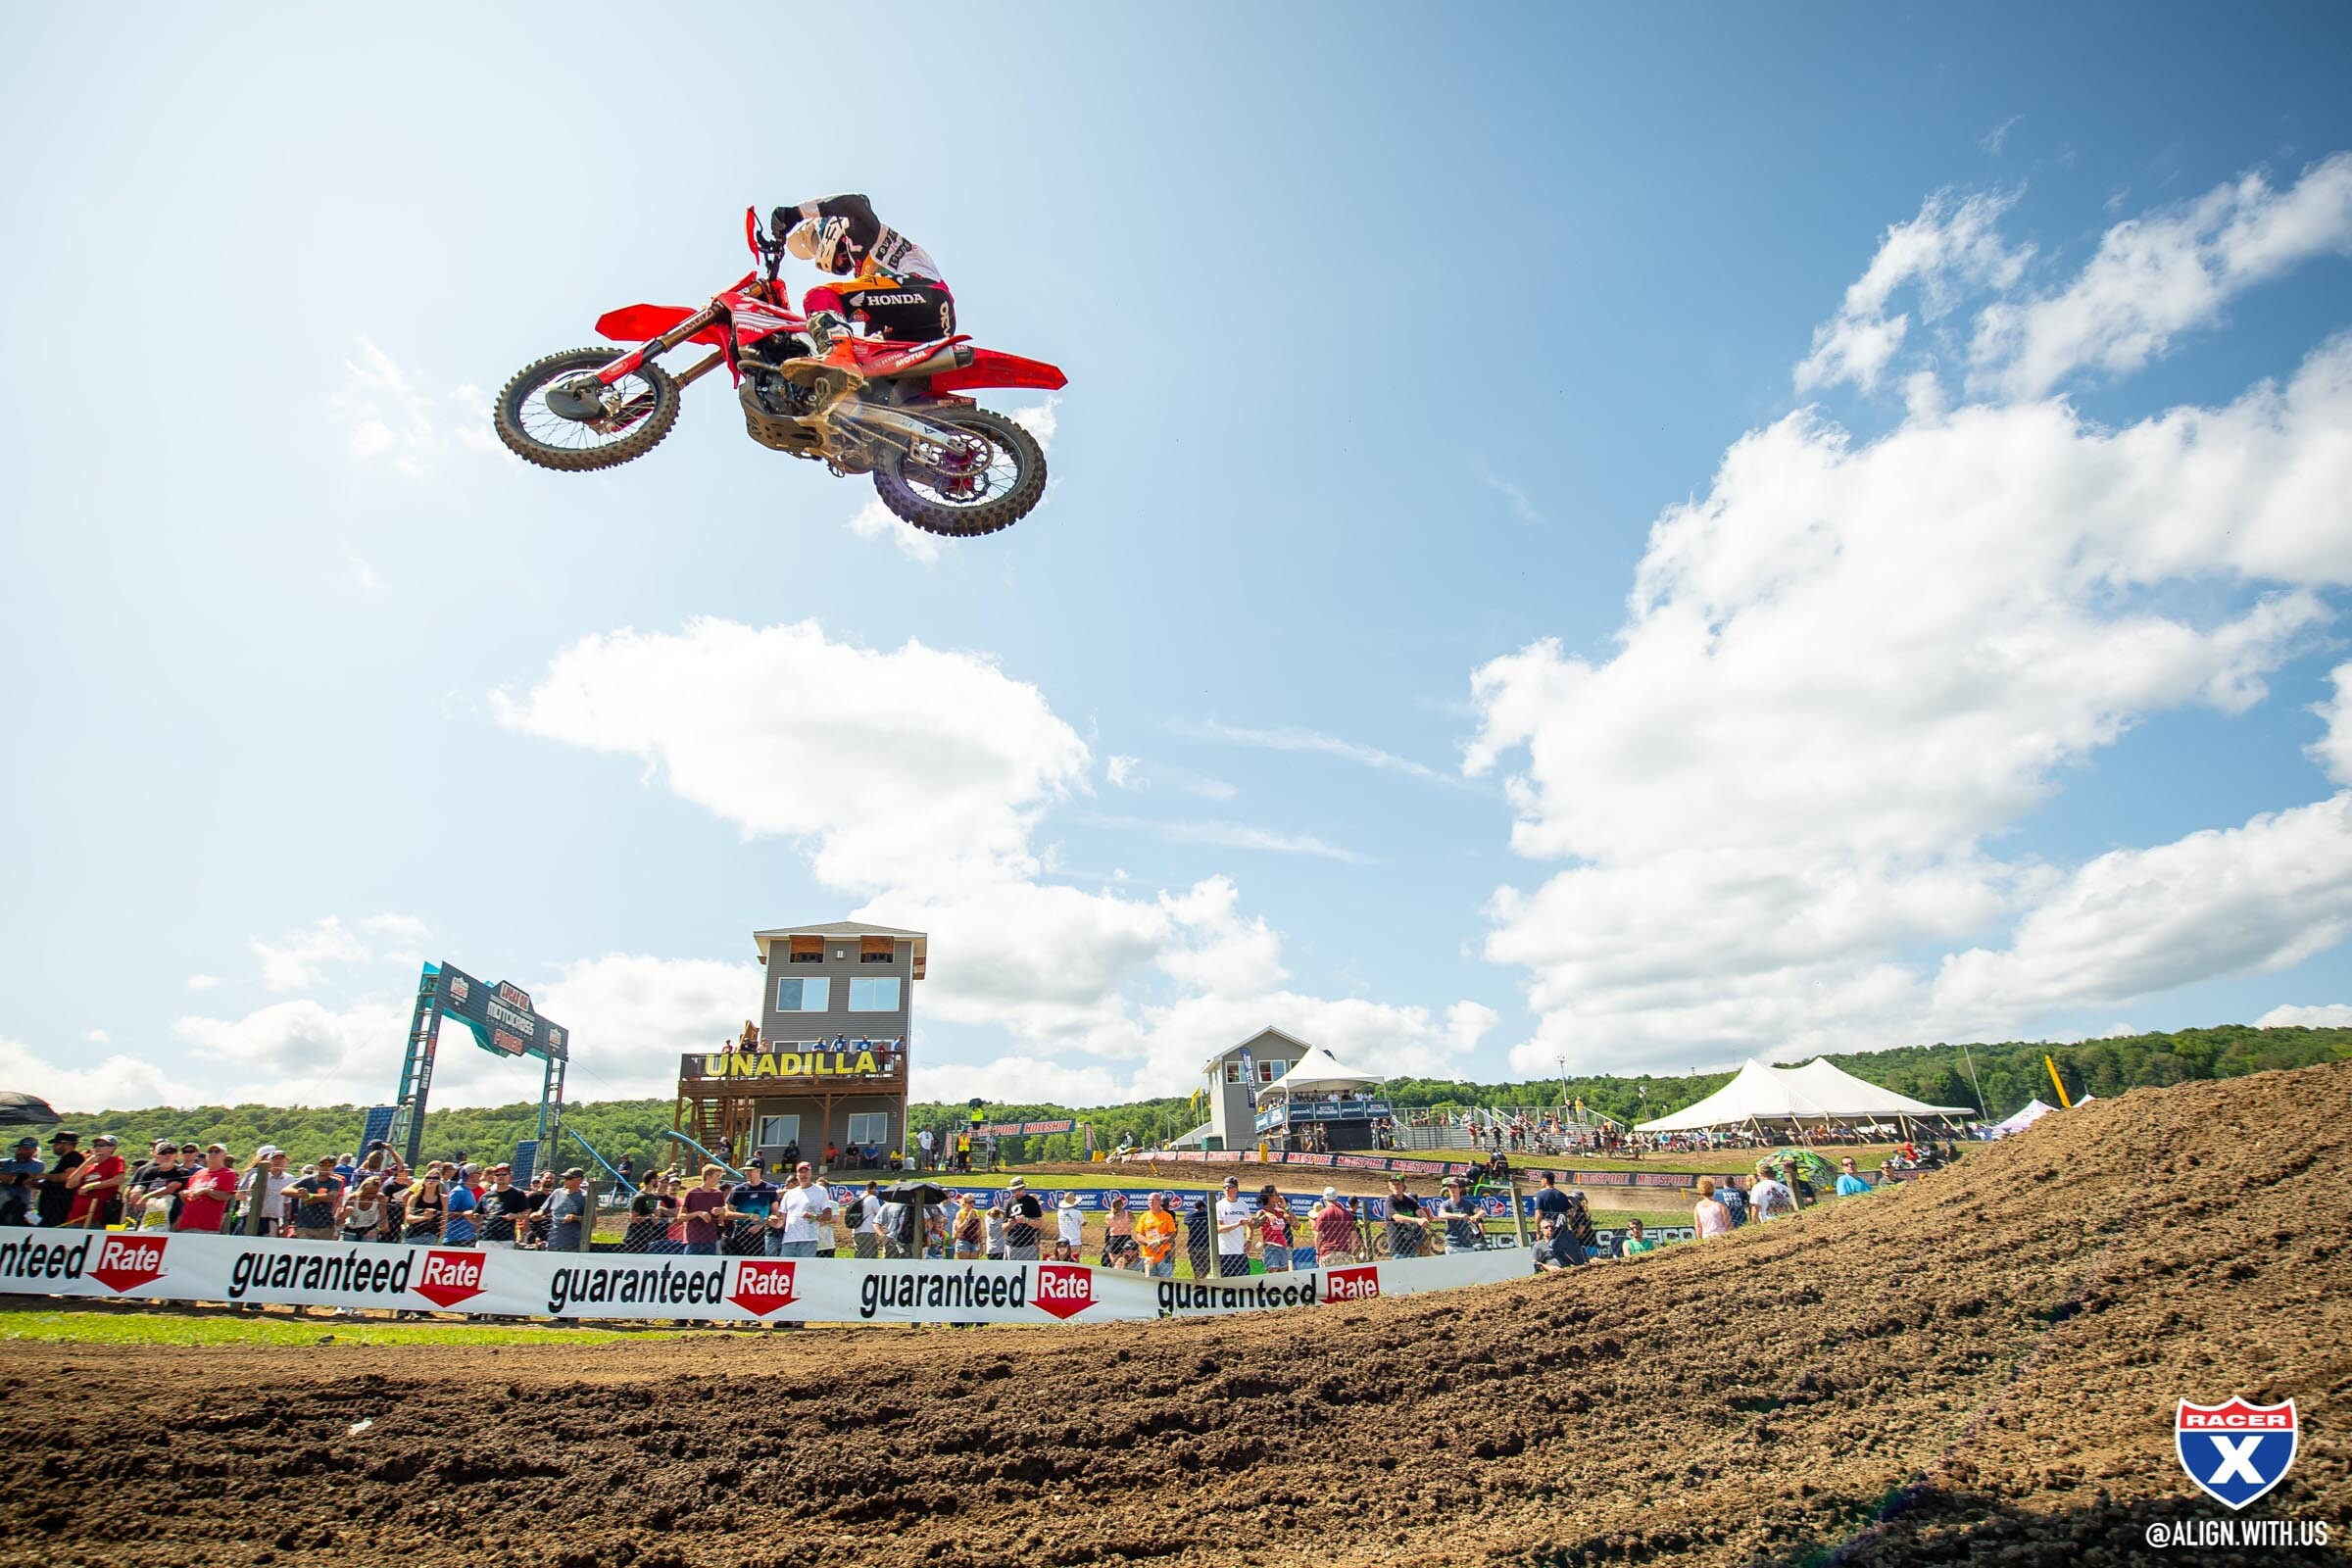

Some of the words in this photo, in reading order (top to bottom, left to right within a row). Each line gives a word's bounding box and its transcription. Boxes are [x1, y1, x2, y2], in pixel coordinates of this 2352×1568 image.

[866, 293, 926, 307] HONDA
[737, 322, 763, 334] MOTUL
[895, 350, 927, 368] MOTUL
[705, 1051, 878, 1076] UNADILLA
[1024, 1121, 1070, 1133] HOLESHOT
[1481, 1197, 1497, 1216] VP
[1626, 1228, 1696, 1245] EICO
[100, 1242, 160, 1272] Rate
[228, 1248, 416, 1298] guaranteed
[423, 1256, 479, 1288] Rate
[548, 1260, 728, 1314] guaranteed
[738, 1266, 790, 1296] Rate
[860, 1264, 1027, 1318] guaranteed
[1040, 1271, 1090, 1299] Rate
[1330, 1276, 1377, 1299] Rate
